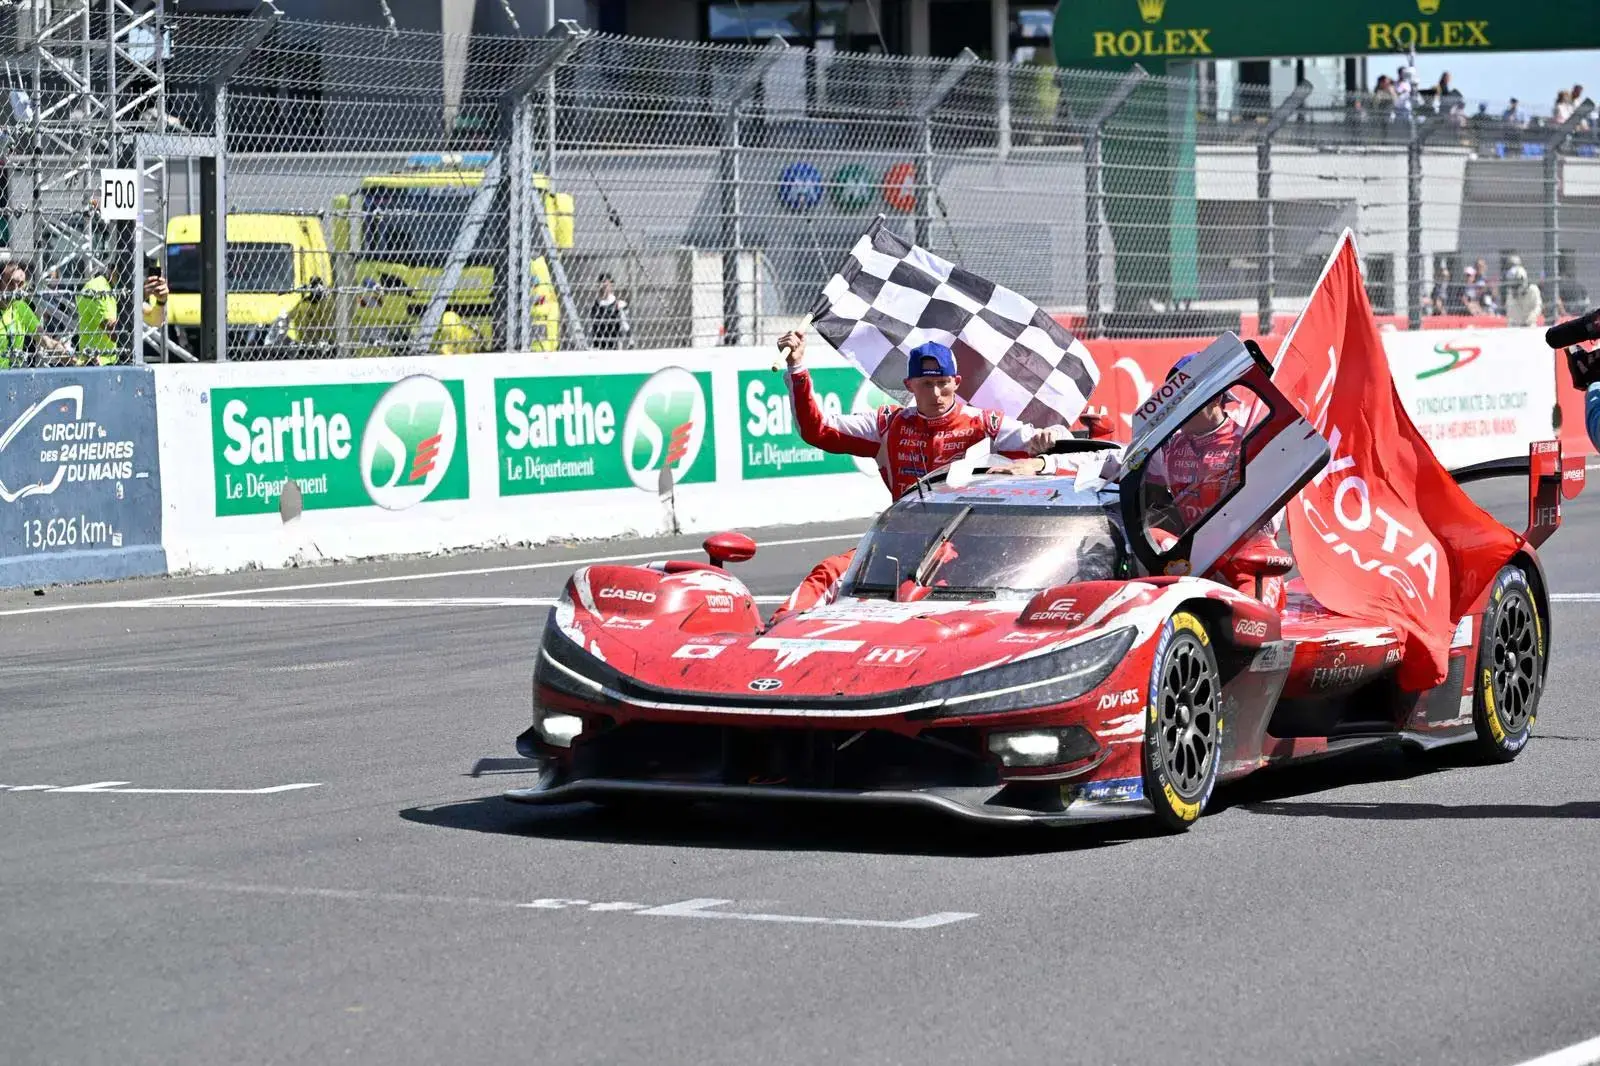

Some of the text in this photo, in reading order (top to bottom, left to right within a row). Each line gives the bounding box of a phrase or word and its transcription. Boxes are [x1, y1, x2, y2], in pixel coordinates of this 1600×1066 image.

[1093, 29, 1212, 57] ROLEX
[1368, 20, 1491, 50] ROLEX
[103, 179, 135, 209] F0.0
[1135, 370, 1192, 421] TOYOTA
[504, 386, 616, 450] Sarthe
[42, 422, 97, 442] CIRCUIT
[222, 397, 352, 466] Sarthe
[40, 441, 134, 462] DES 24 HEURES
[748, 443, 762, 466] Le
[67, 461, 133, 482] DU MANS
[506, 455, 595, 485] Le Département
[225, 473, 243, 499] Le
[23, 515, 106, 551] 13,626 km
[1266, 555, 1293, 567] DENSO
[599, 588, 657, 603] CASIO
[1029, 611, 1085, 621] EDIFICE
[1235, 619, 1268, 638] RAYS
[864, 647, 915, 663] HY
